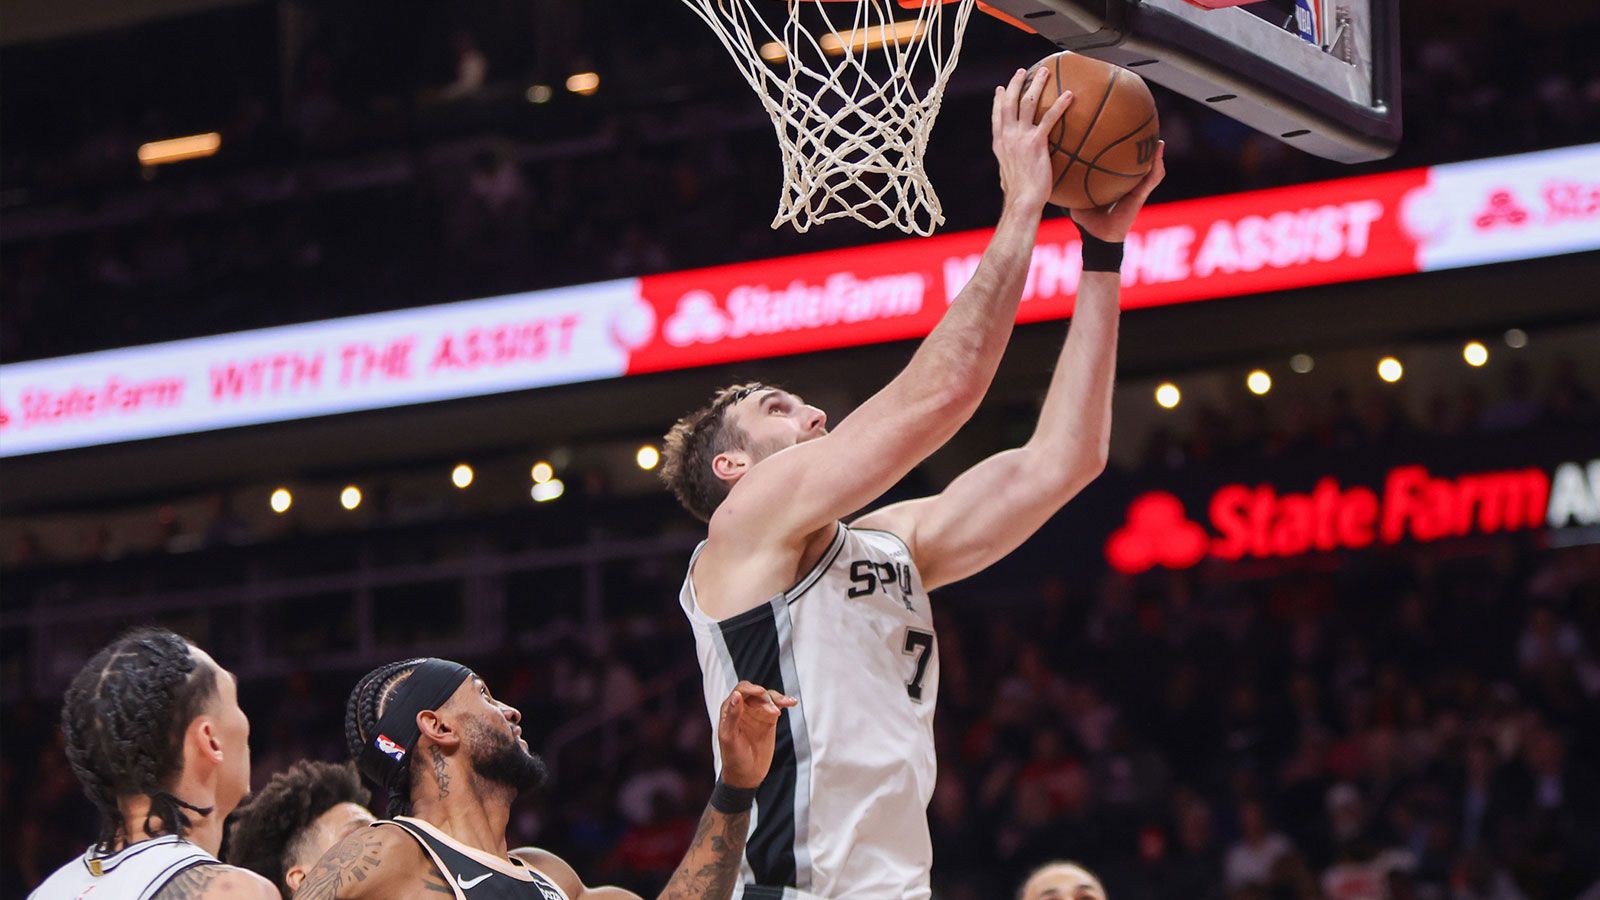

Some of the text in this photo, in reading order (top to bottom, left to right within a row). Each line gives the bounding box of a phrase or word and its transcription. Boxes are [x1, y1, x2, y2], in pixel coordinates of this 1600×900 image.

[943, 240, 1082, 307] WTH
[1194, 200, 1384, 278] ASSIST
[208, 350, 325, 401] WITH
[340, 335, 418, 385] THE
[429, 313, 582, 371] ASSIST
[903, 626, 935, 704] 7
